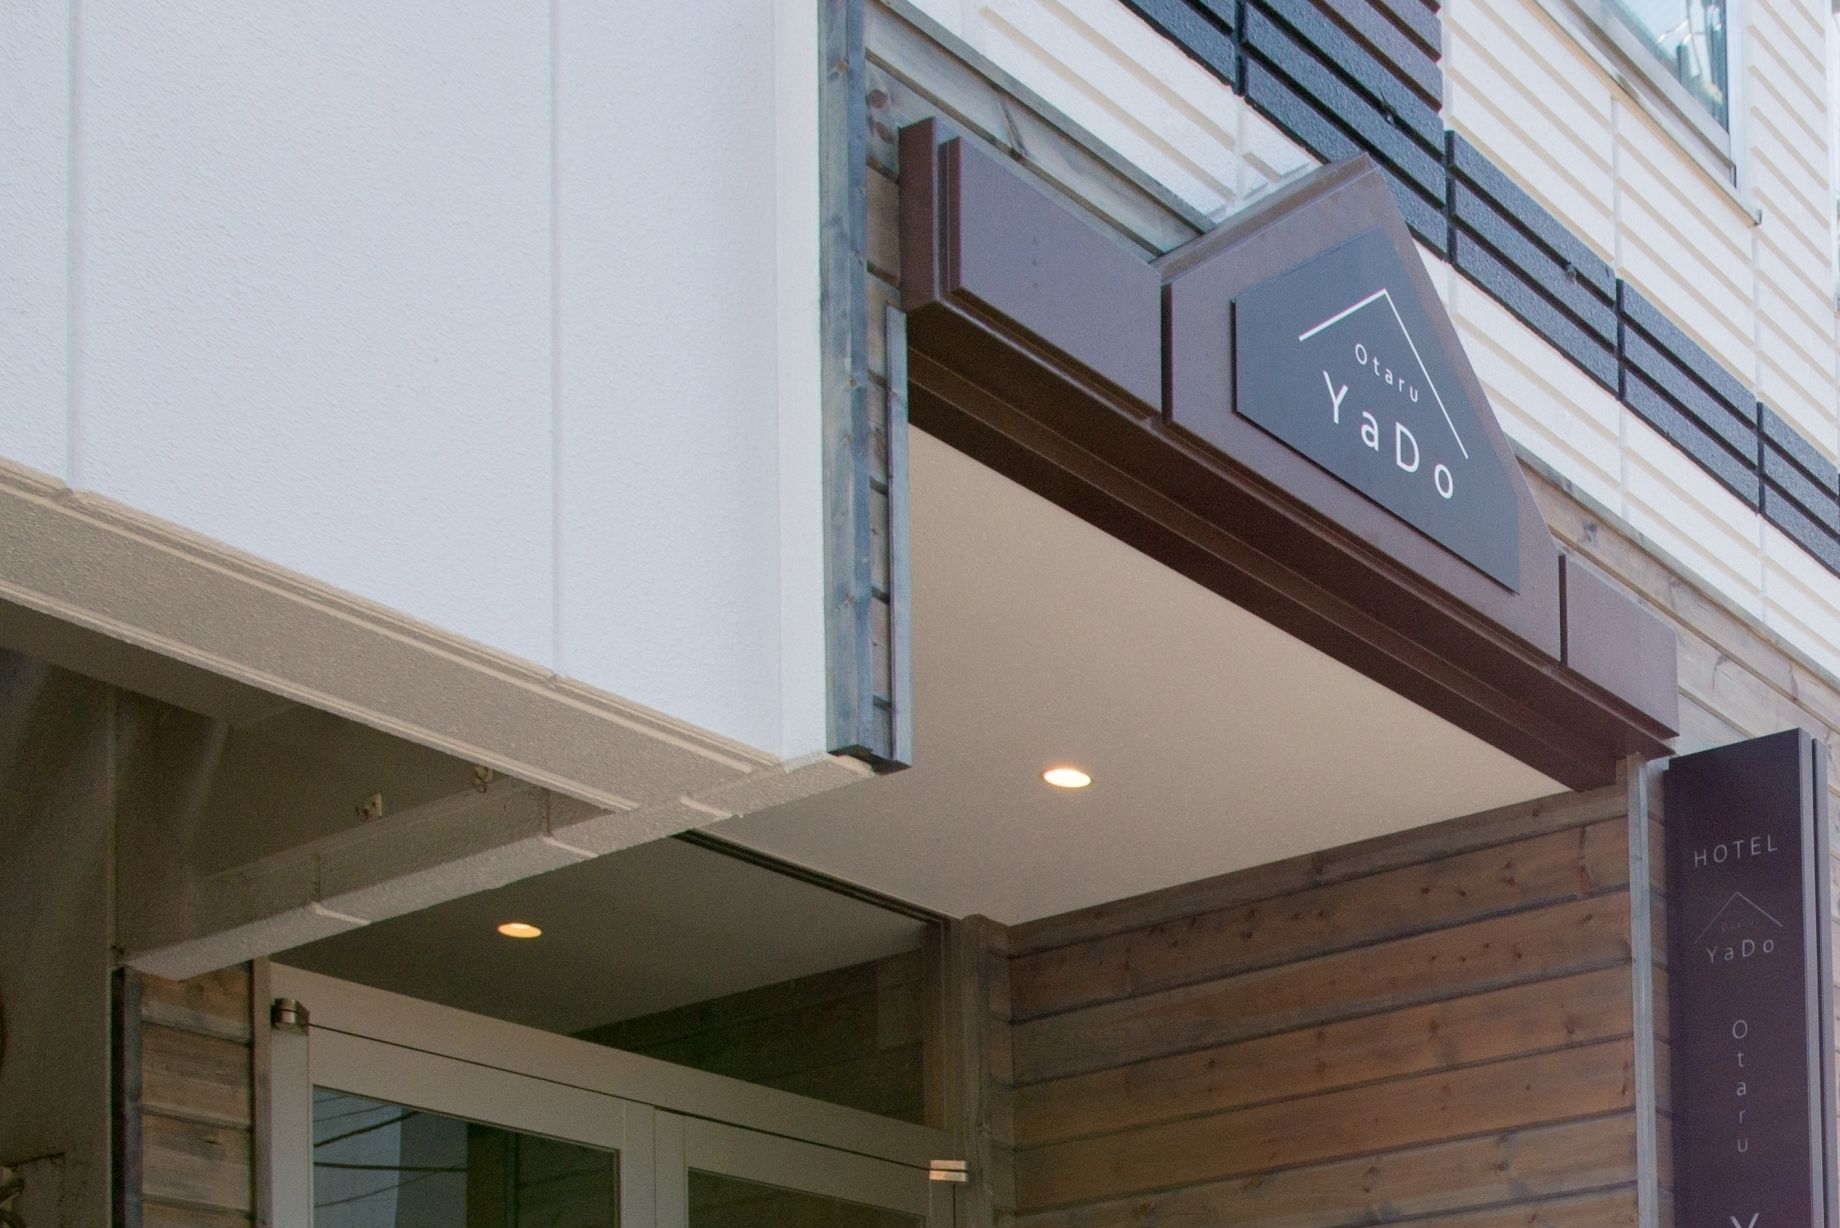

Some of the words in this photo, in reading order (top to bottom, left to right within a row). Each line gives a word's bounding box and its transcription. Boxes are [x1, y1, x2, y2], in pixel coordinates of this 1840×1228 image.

[1354, 342, 1420, 404] Otaru
[1322, 370, 1456, 500] YaDo
[1693, 834, 1780, 869] HOTEL
[1705, 936, 1775, 964] YaDo
[1731, 1019, 1750, 1155] Otaru
